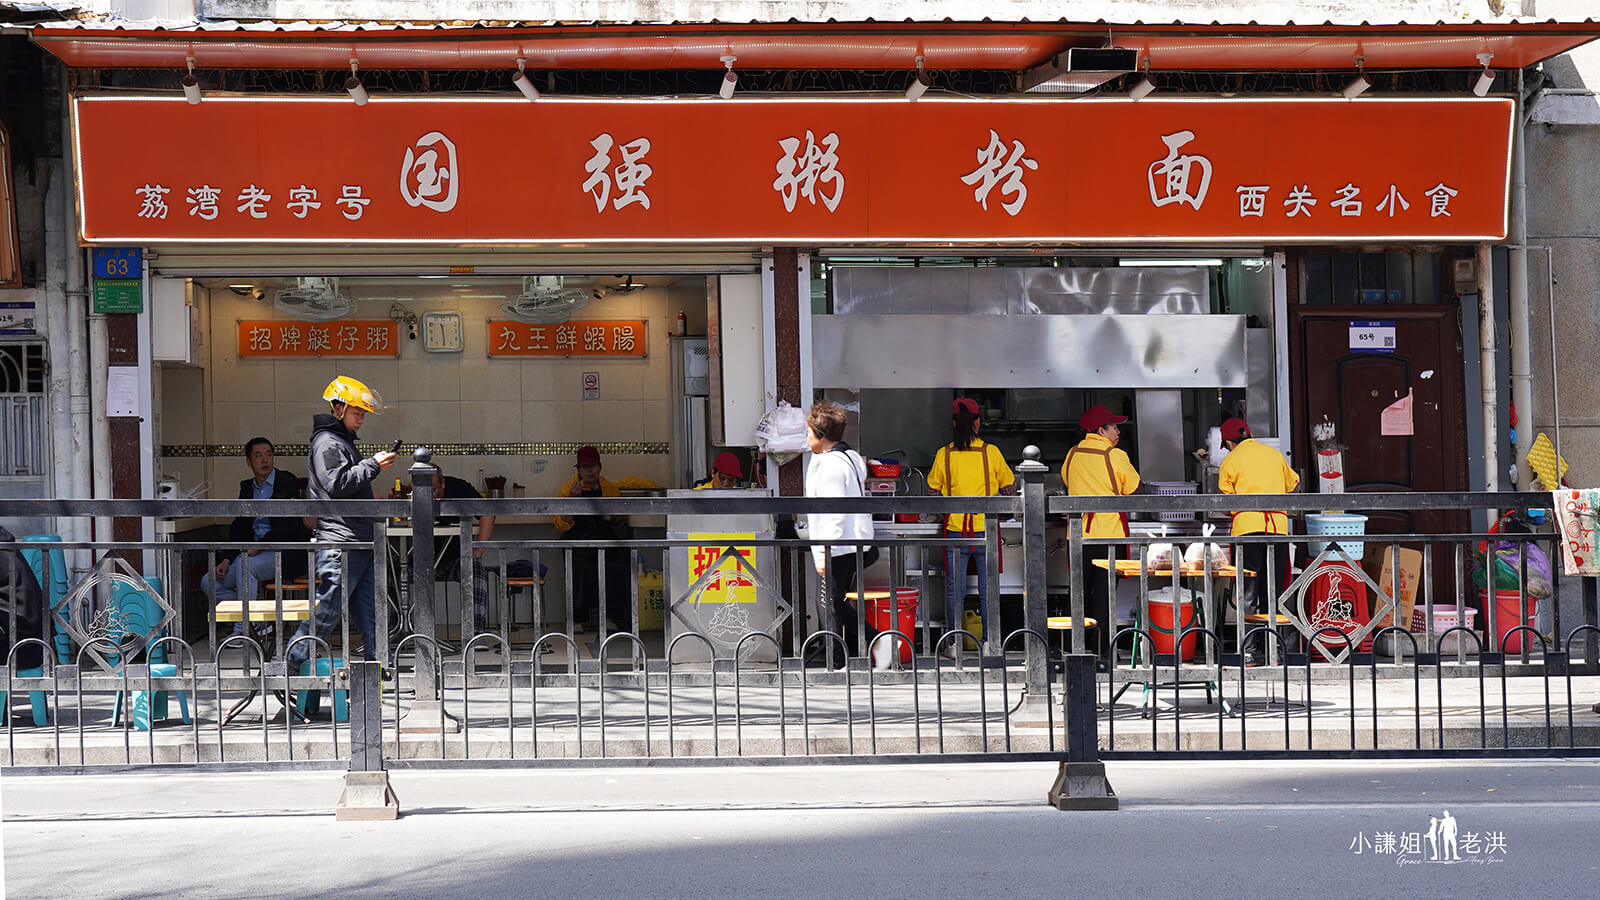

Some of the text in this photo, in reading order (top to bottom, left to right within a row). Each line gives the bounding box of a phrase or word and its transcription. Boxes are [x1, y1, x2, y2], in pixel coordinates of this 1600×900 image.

[399, 130, 1213, 216] 国强粥粉面
[135, 184, 371, 220] 荔湾老字号
[1236, 183, 1458, 218] 西关名小食
[106, 258, 129, 275] 63
[249, 325, 388, 351] 招牌艇仔粥
[1358, 332, 1375, 341] 65号
[693, 546, 753, 591] 招工
